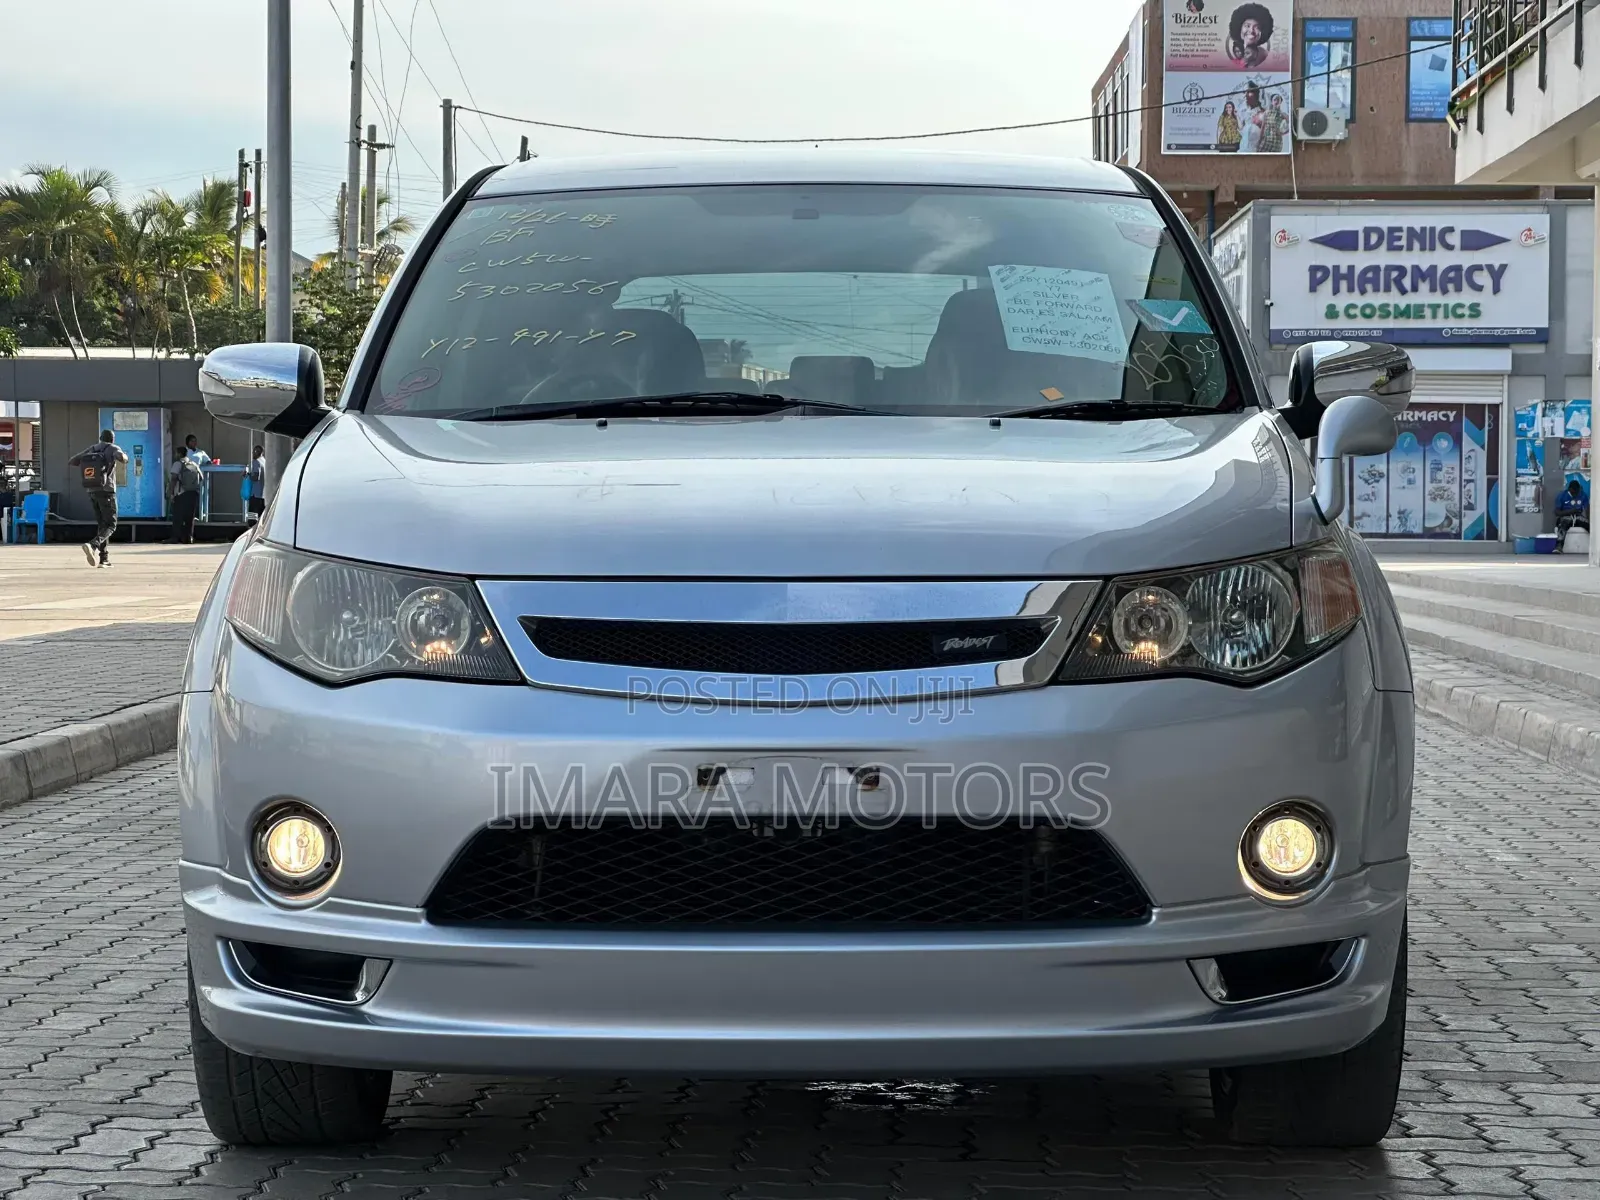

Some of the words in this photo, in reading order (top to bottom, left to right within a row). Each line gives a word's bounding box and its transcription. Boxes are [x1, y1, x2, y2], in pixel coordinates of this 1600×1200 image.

[1171, 12, 1219, 24] Bizzlest
[1362, 226, 1455, 251] DENIC
[1308, 264, 1508, 296] PHARMACY
[448, 278, 620, 302] 5302056
[1032, 290, 1080, 301] SILVER
[1036, 300, 1103, 313] FORWARD
[1325, 303, 1340, 319] &
[1344, 302, 1482, 319] COSMETICS
[1007, 307, 1034, 315] DAR
[1059, 311, 1113, 323] SALAAM
[1011, 326, 1077, 338] EUPHONY
